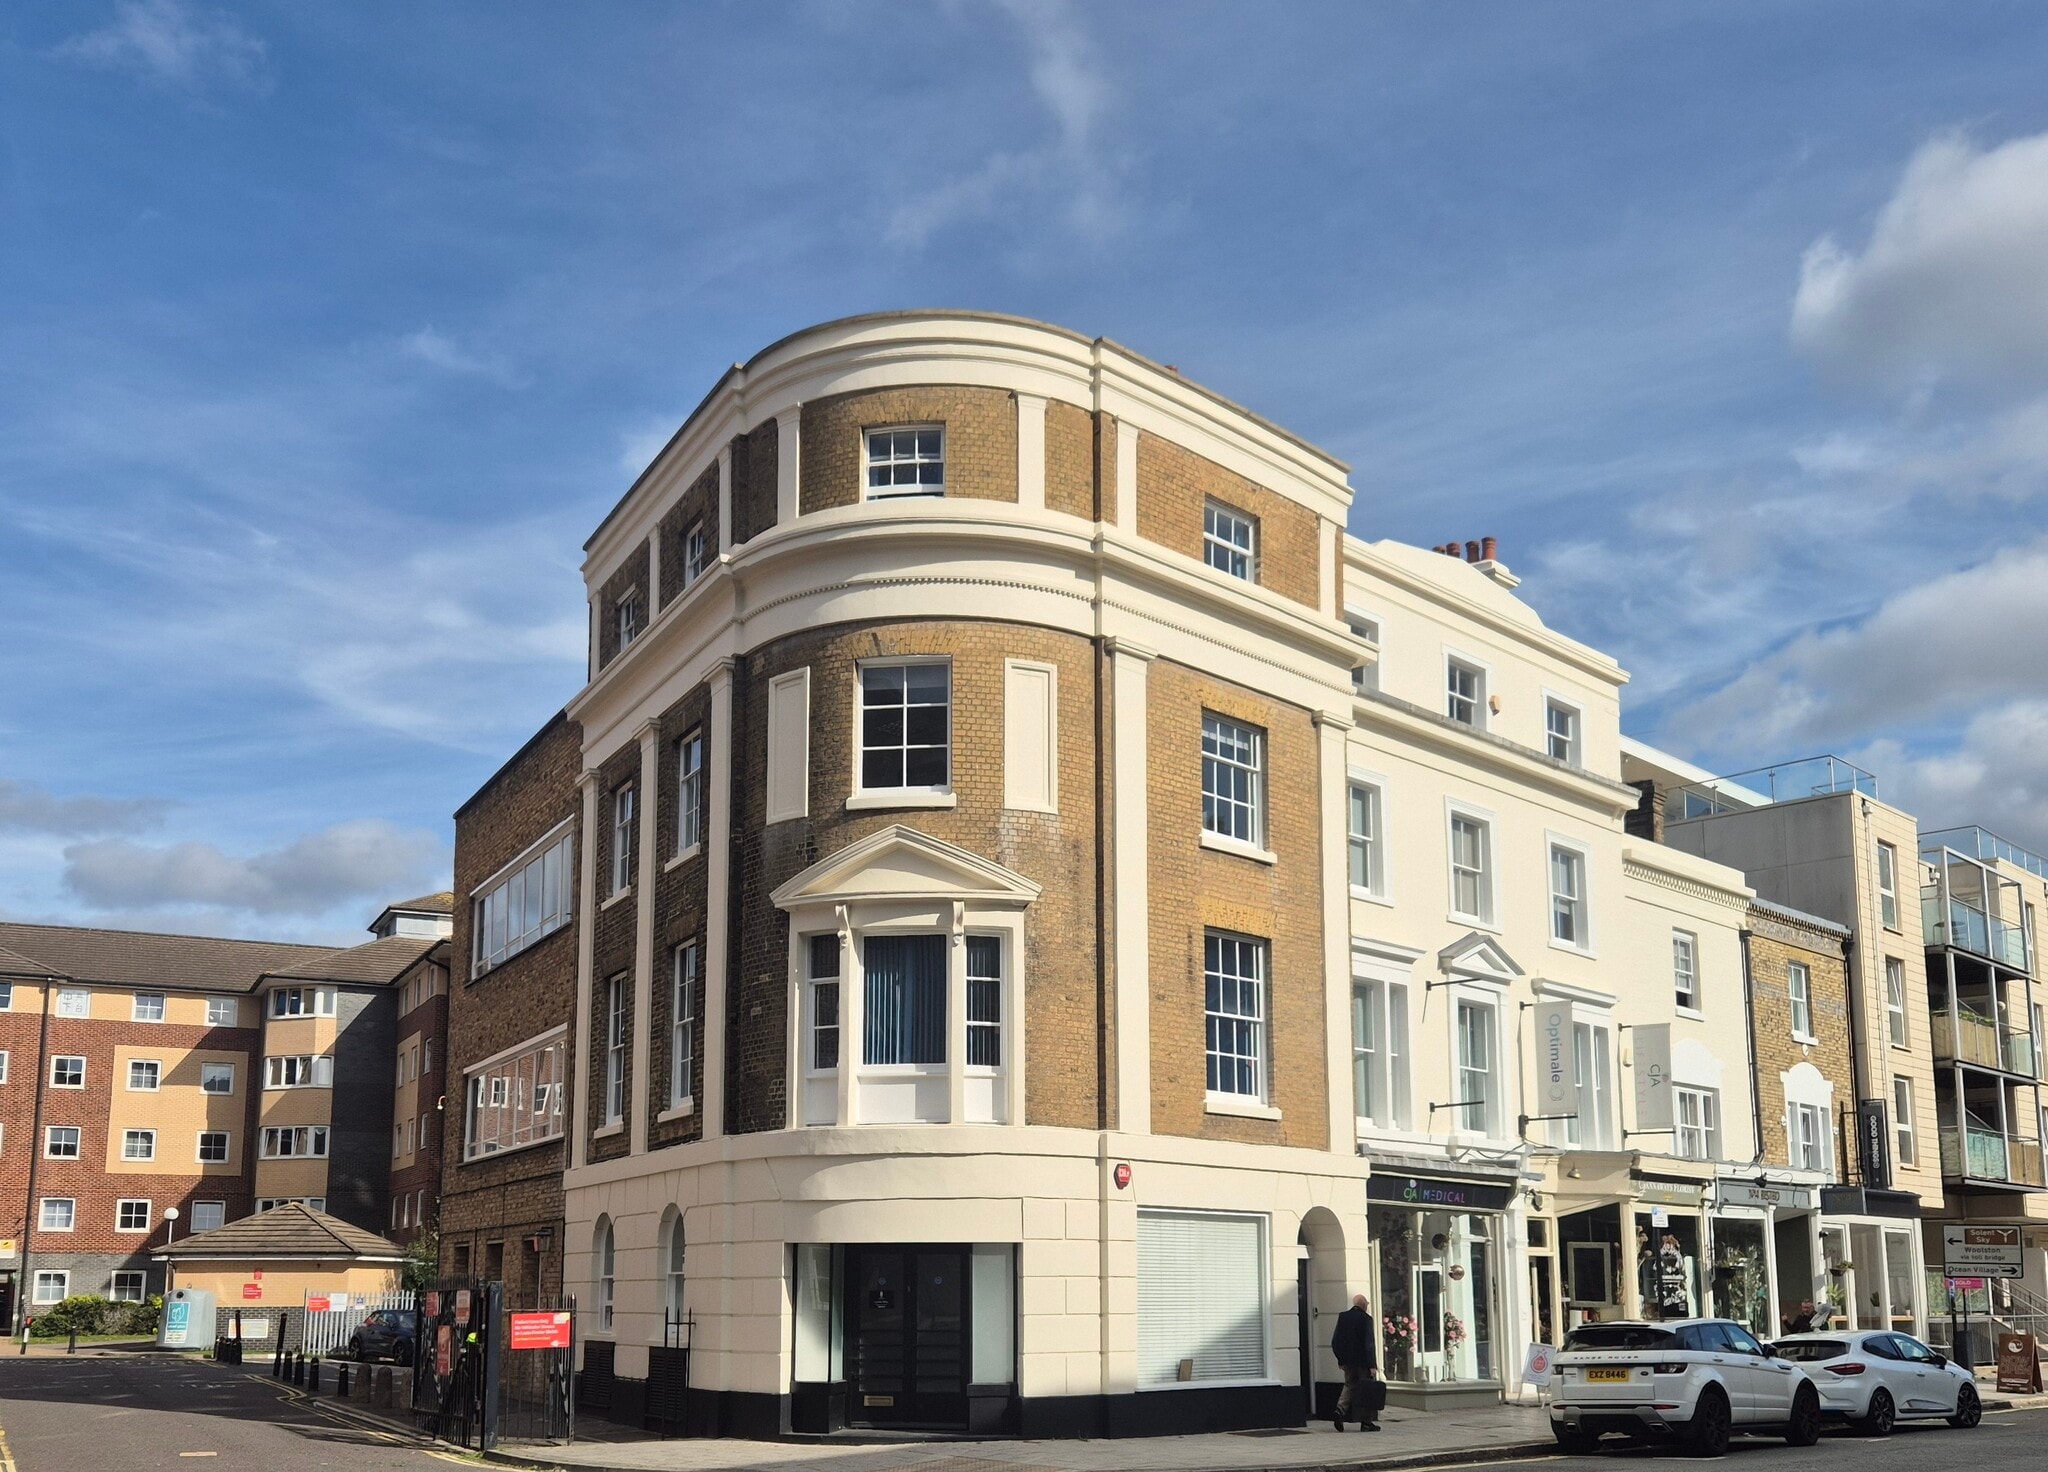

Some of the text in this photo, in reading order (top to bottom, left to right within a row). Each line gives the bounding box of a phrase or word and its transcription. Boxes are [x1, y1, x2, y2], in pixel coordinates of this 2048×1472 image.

[1545, 1013, 1563, 1083] Optimale
[1870, 1115, 1878, 1138] GOOD
[1423, 1189, 1465, 1204] MEDICAL
[1948, 1265, 1999, 1274] Ocean Village
[1589, 1370, 1604, 1379] EXZ
